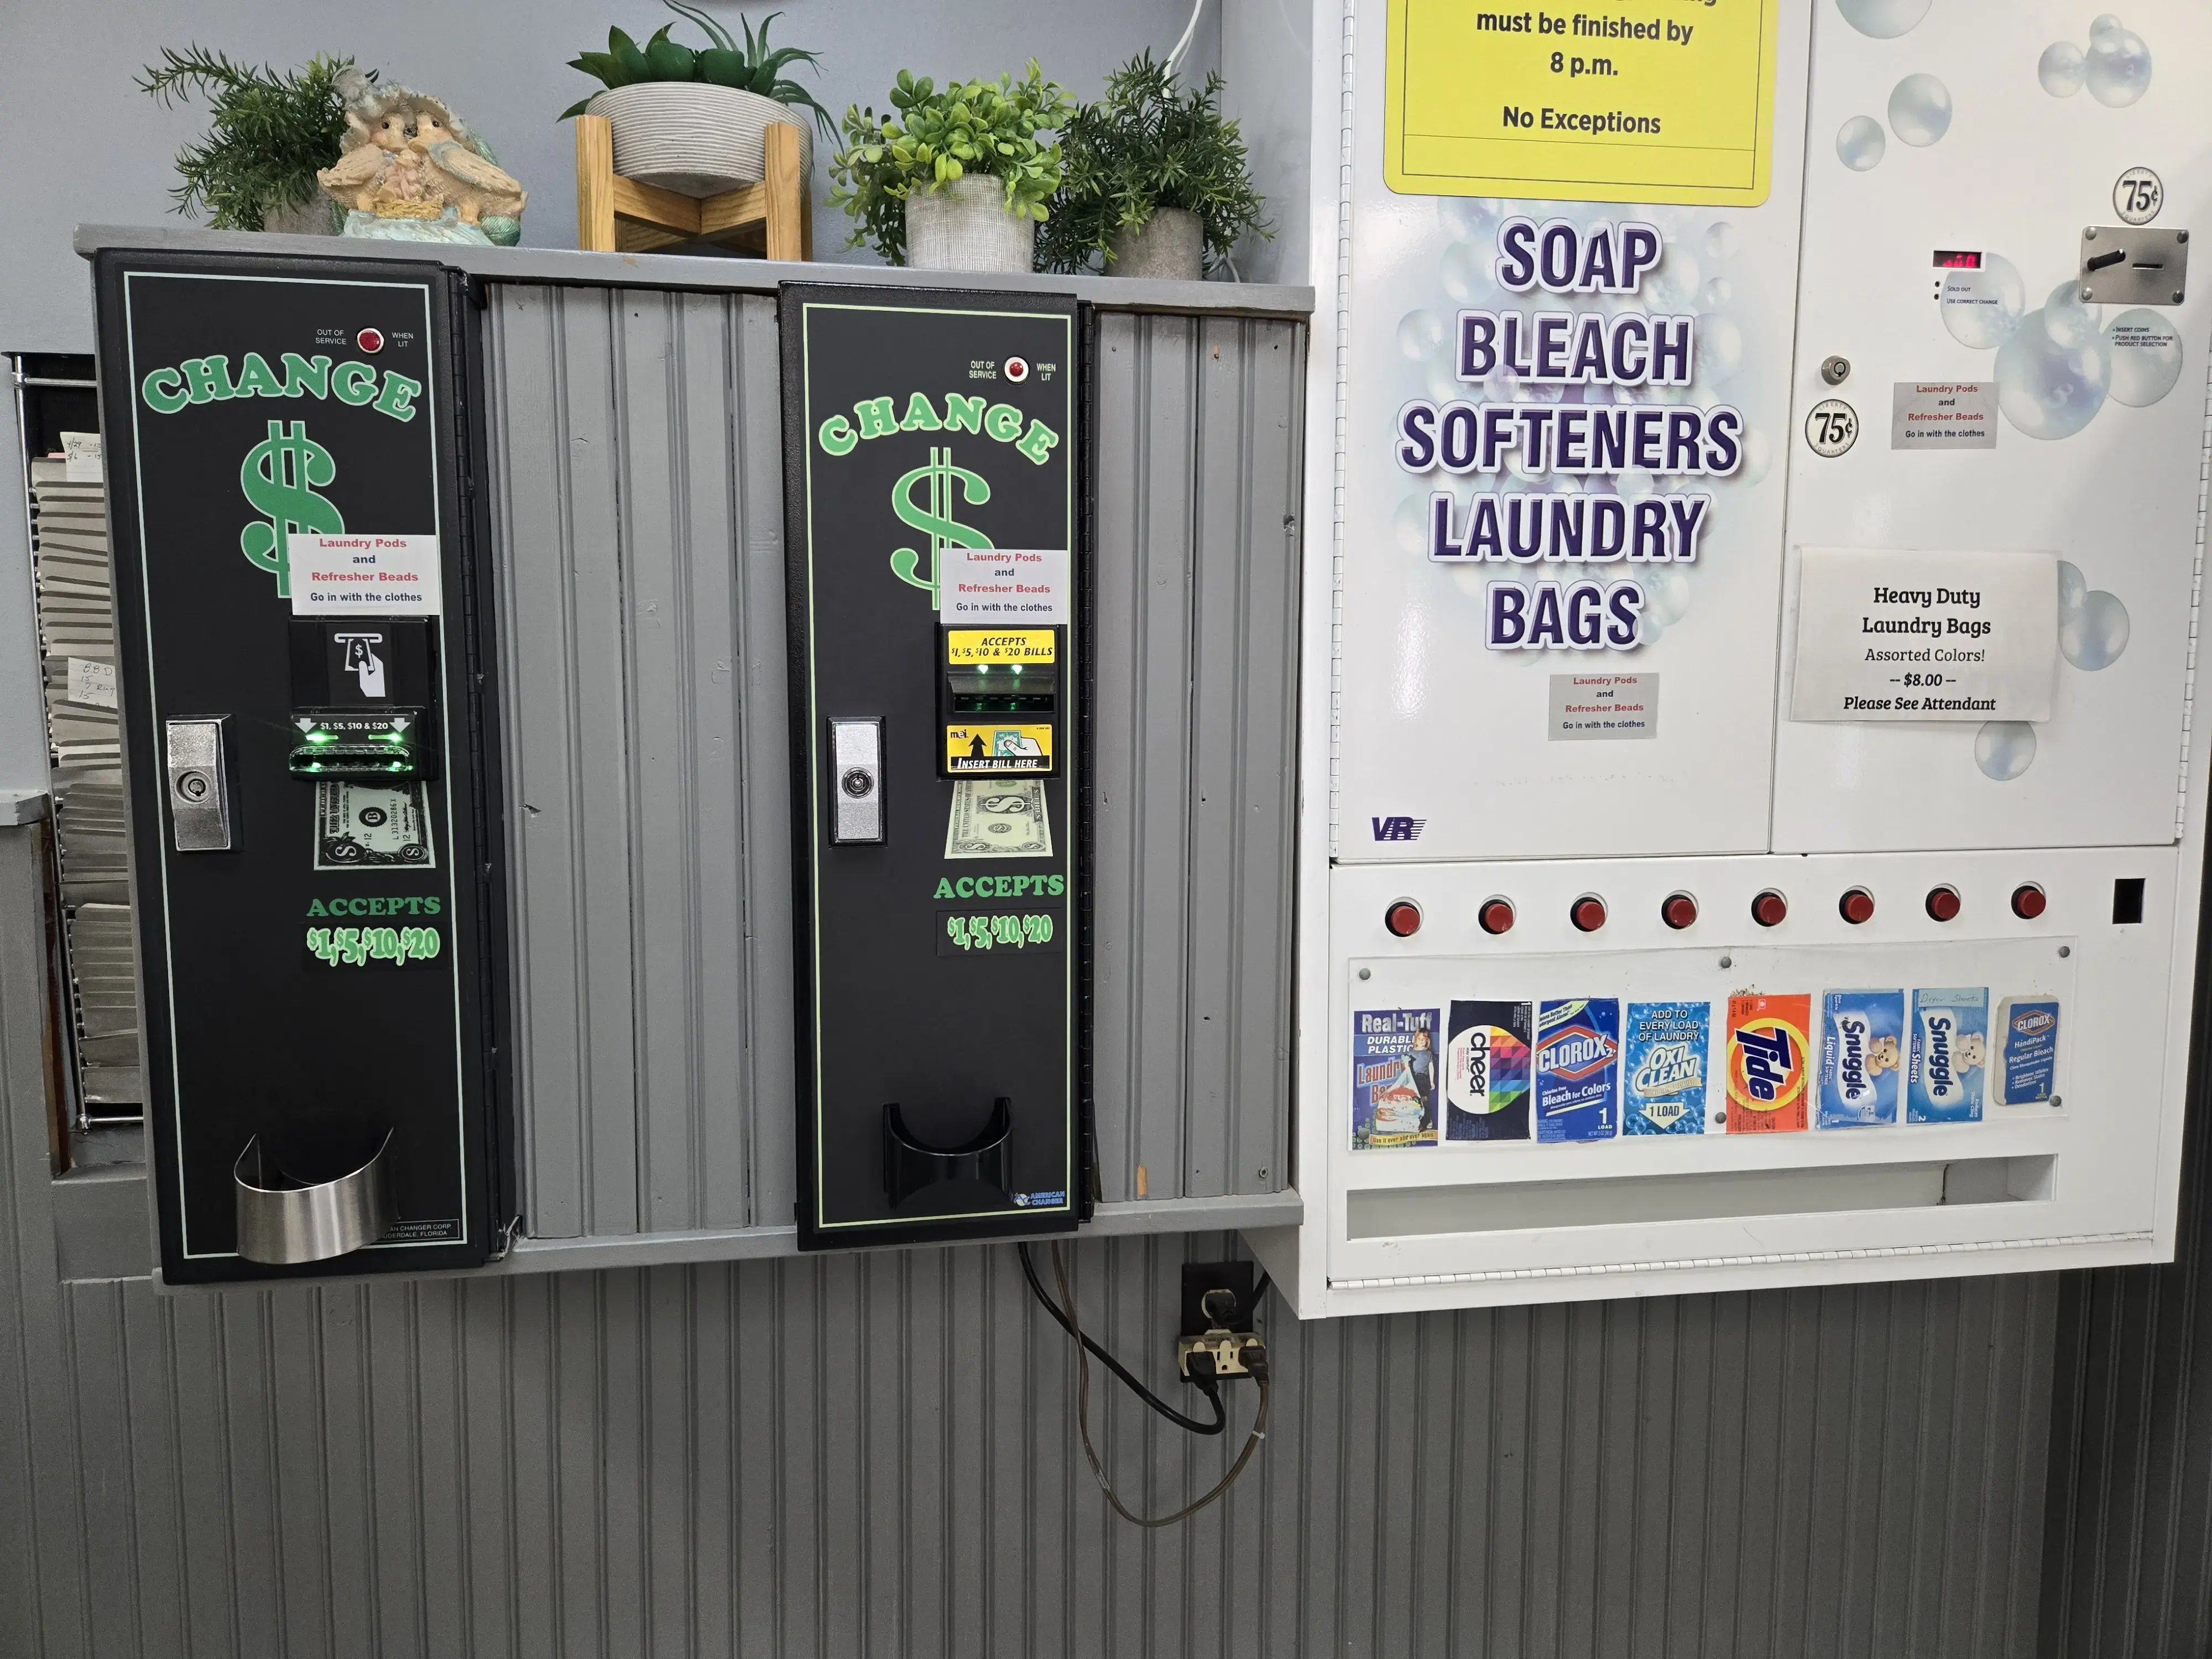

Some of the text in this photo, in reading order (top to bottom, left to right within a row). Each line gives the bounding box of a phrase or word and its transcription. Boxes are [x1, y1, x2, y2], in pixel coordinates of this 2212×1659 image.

[1477, 12, 1693, 45] must be finished by
[1550, 52, 1618, 78] 8 p.m.
[1503, 106, 1661, 135] No Exceptions
[2122, 180, 2158, 212] 75¢
[1498, 220, 1659, 290] SOAP
[315, 337, 346, 345] SERVICE
[1458, 313, 1691, 383] BLEACH
[987, 361, 995, 369] OF
[1037, 363, 1056, 372] WHEN
[969, 371, 997, 379] SERVICE
[1041, 373, 1051, 381] LIT
[143, 352, 421, 422] CHANGE
[1916, 385, 1953, 394] Laundry
[819, 392, 1058, 465] CHANGE
[1815, 413, 1853, 444] 75¢
[1397, 403, 1740, 472] SOFTENERS
[1432, 495, 1707, 559] LAUNDRY
[319, 538, 406, 549] Laundry Pods
[352, 555, 375, 564] and
[967, 553, 1042, 563] Laundry Pods
[311, 572, 419, 581] Refresher Beads
[994, 568, 1015, 576] and
[958, 584, 1050, 593] Refresher Beads
[310, 592, 422, 602] Go in with the clothes
[1874, 587, 1980, 608] Heavy Duty
[956, 602, 1053, 612] Go in with the clothes
[1489, 584, 1642, 647] BAGS
[1862, 617, 1991, 638] Laundry Bags
[981, 637, 1026, 646] ACCEPTS
[952, 648, 960, 658] $1,
[962, 648, 974, 657] $5,
[975, 648, 989, 656] $10
[1005, 648, 1020, 656] $20
[1024, 647, 1052, 656] BILLS
[1865, 648, 1985, 662] Assorted Colors!
[1573, 677, 1611, 686] Laundry
[1904, 672, 1943, 687] $8.00
[1844, 697, 1996, 711] Please See Attendant
[320, 722, 332, 731] $1,
[333, 722, 346, 731] $5,
[957, 758, 1037, 769] INSERT BILL HERE
[933, 875, 1064, 899] ACCEPTS
[306, 897, 441, 916] ACCEPTS
[1651, 1010, 1688, 1019] ADD TO
[2017, 1013, 2051, 1030] CLOROX
[1362, 1013, 1432, 1033] Real-Tuff
[1640, 1021, 1699, 1030] EVERY LOAD
[1368, 1036, 1415, 1045] DURABL
[1639, 1031, 1699, 1041] OF LAUNDRY
[2015, 1035, 2046, 1048] HandiPack
[1650, 1045, 1686, 1071] OXI
[1824, 1036, 1836, 1065] Liquid
[1928, 1017, 1953, 1096] Snuggle
[2009, 1052, 2032, 1063] Regular
[2034, 1046, 2053, 1055] Bleach
[1734, 1027, 1793, 1102] Tide
[1842, 1020, 1866, 1099] Snuggle
[1635, 1057, 1697, 1092] CLEAN
[1910, 1053, 1921, 1083] Sheets
[1542, 1090, 1571, 1107] Bleach
[1582, 1083, 1610, 1097] Colors
[1599, 1108, 1607, 1124] 1
[1650, 1106, 1679, 1117] 1 LOAD
